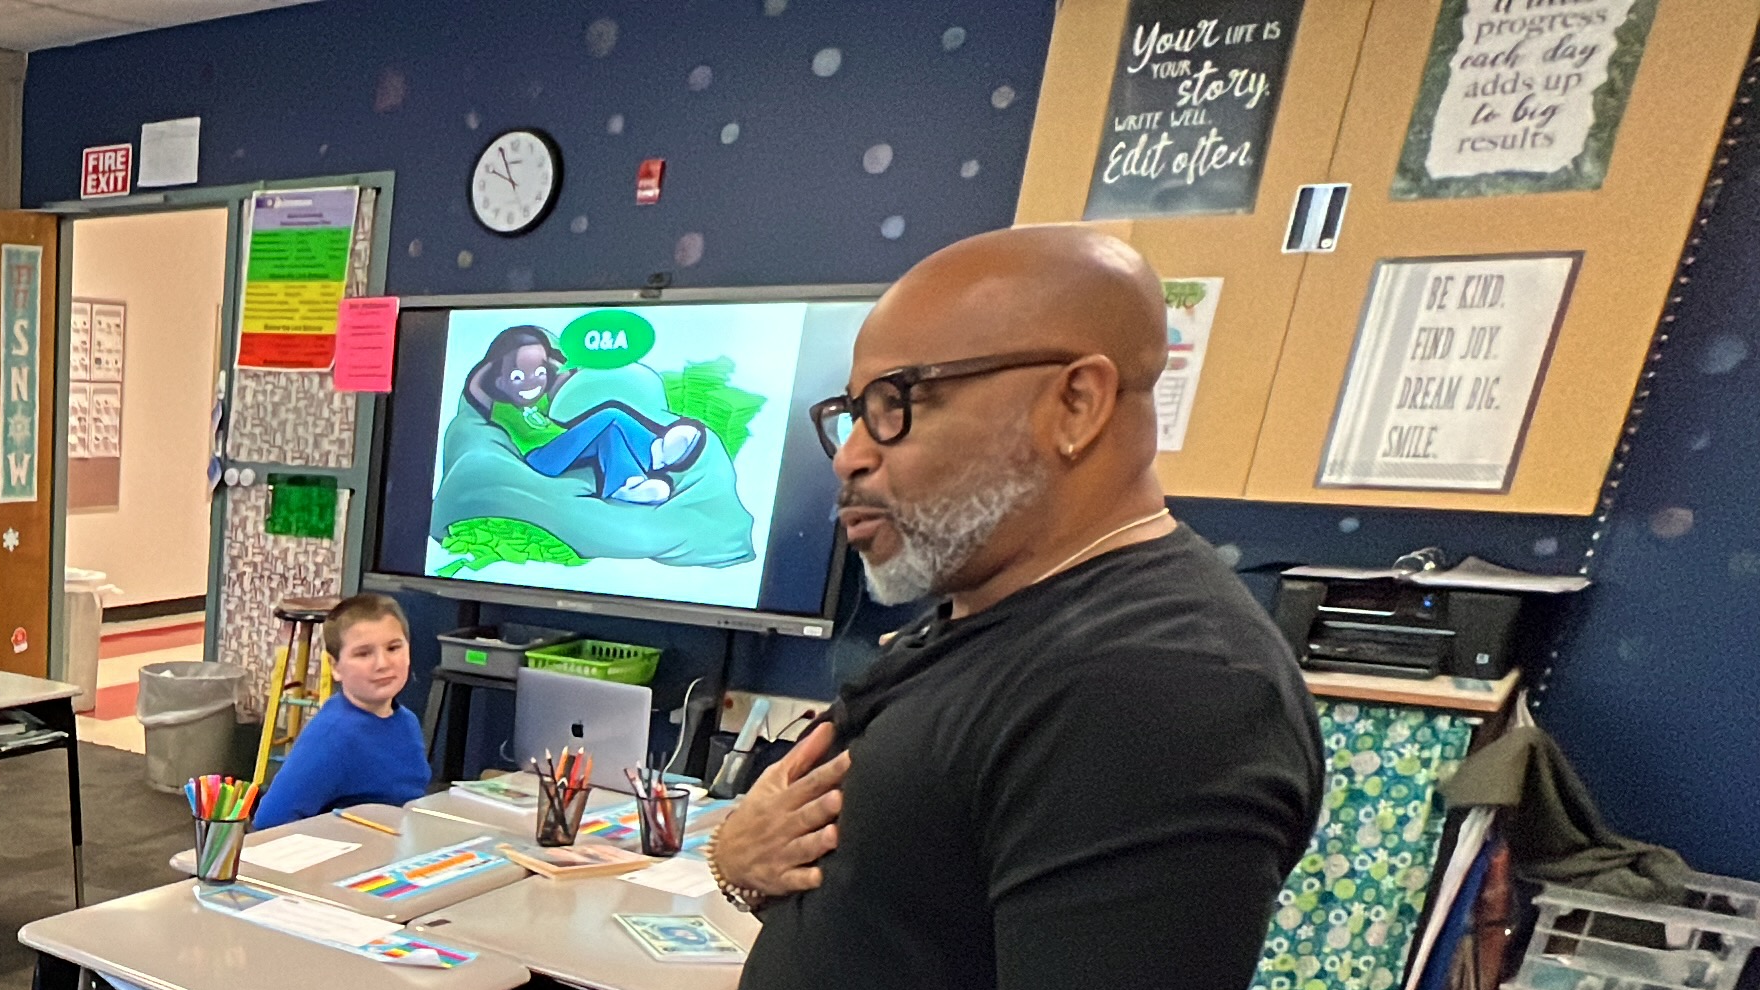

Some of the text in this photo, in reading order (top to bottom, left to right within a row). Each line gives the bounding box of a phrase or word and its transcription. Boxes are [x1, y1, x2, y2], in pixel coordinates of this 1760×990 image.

[1474, 8, 1608, 45] progress
[1127, 19, 1281, 73] Your LIFE IS
[1542, 33, 1599, 68] day
[1151, 60, 1191, 79] YOUR
[1464, 71, 1583, 98] adds up
[1114, 111, 1163, 132] WRITE
[1512, 93, 1562, 128] big
[1457, 126, 1556, 154] results
[88, 150, 127, 172] FIRE
[1103, 131, 1174, 184] Edit
[86, 172, 126, 194] EXIT
[1426, 276, 1454, 310] BE
[584, 329, 629, 351] Q&A
[1411, 327, 1455, 360] FIND
[1396, 375, 1462, 410] DREAM
